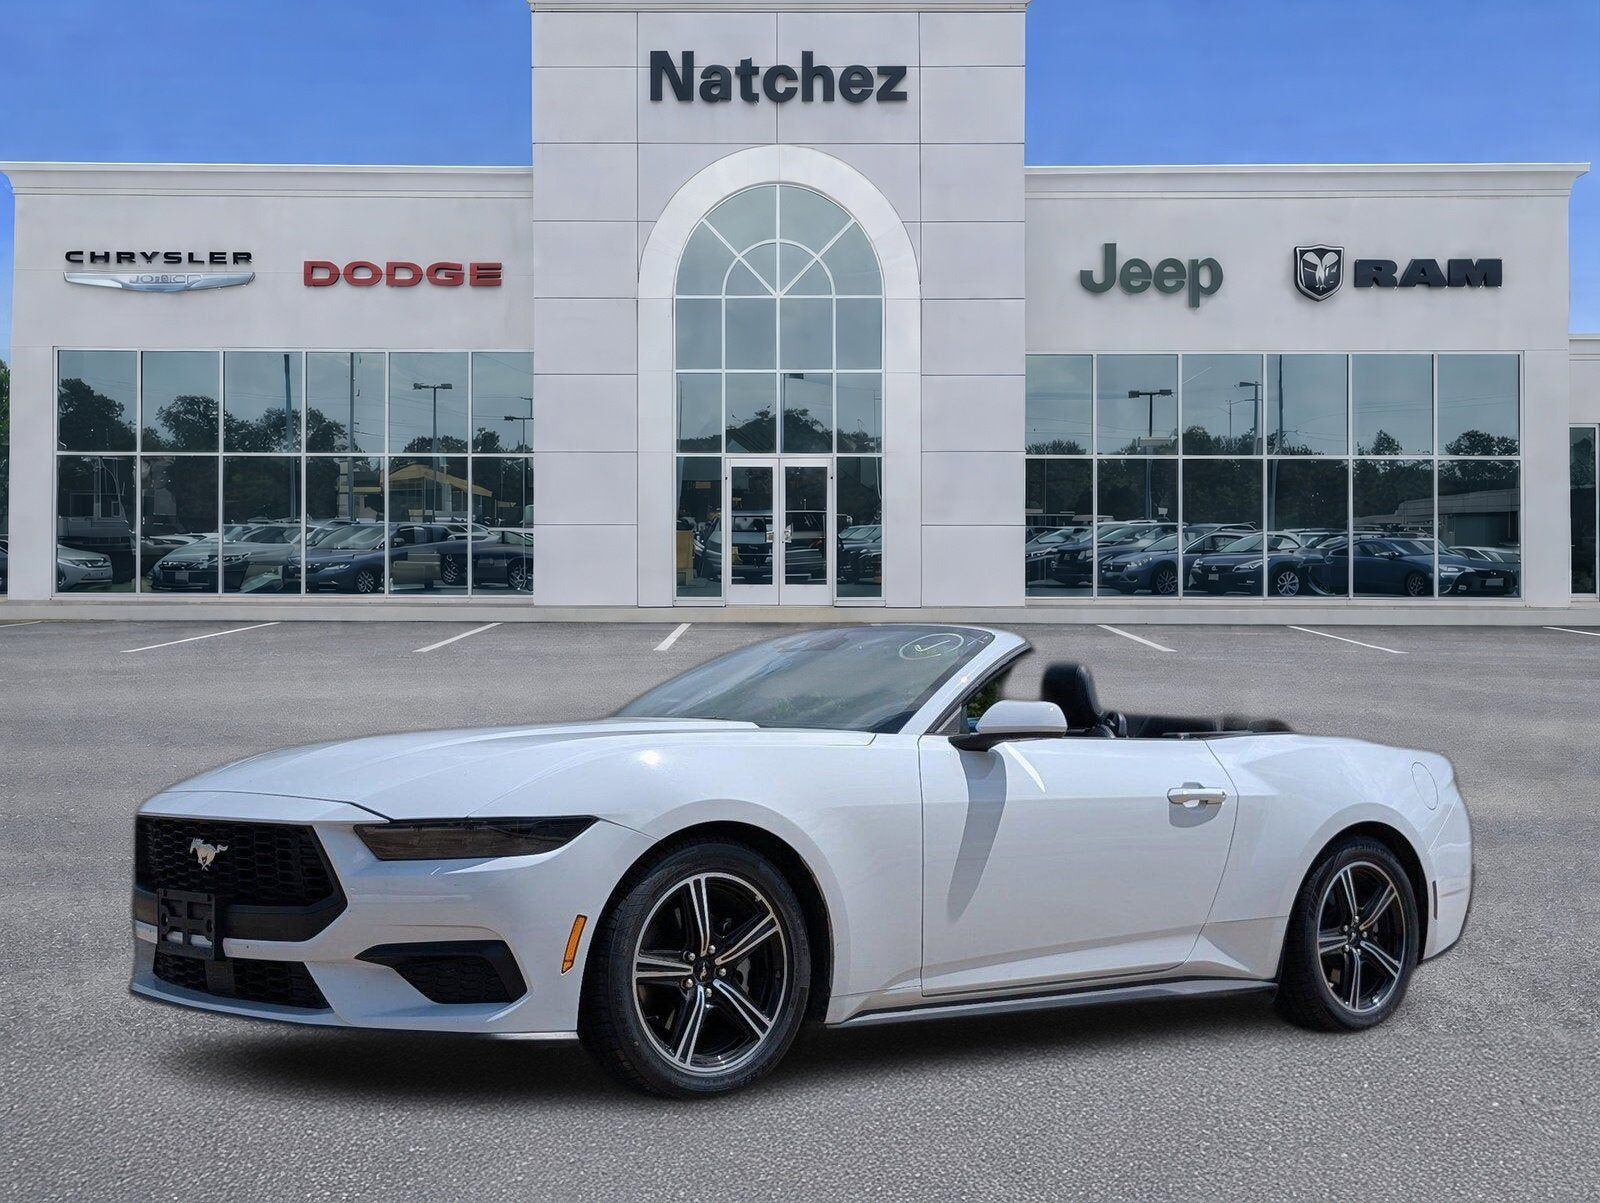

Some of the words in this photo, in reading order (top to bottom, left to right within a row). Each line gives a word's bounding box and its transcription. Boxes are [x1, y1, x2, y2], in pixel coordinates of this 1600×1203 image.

[650, 51, 908, 103] Natchez
[65, 250, 253, 265] CHRYSLER
[303, 260, 503, 287] DODGE
[1079, 242, 1224, 308] Jeep
[1353, 258, 1503, 288] RAM
